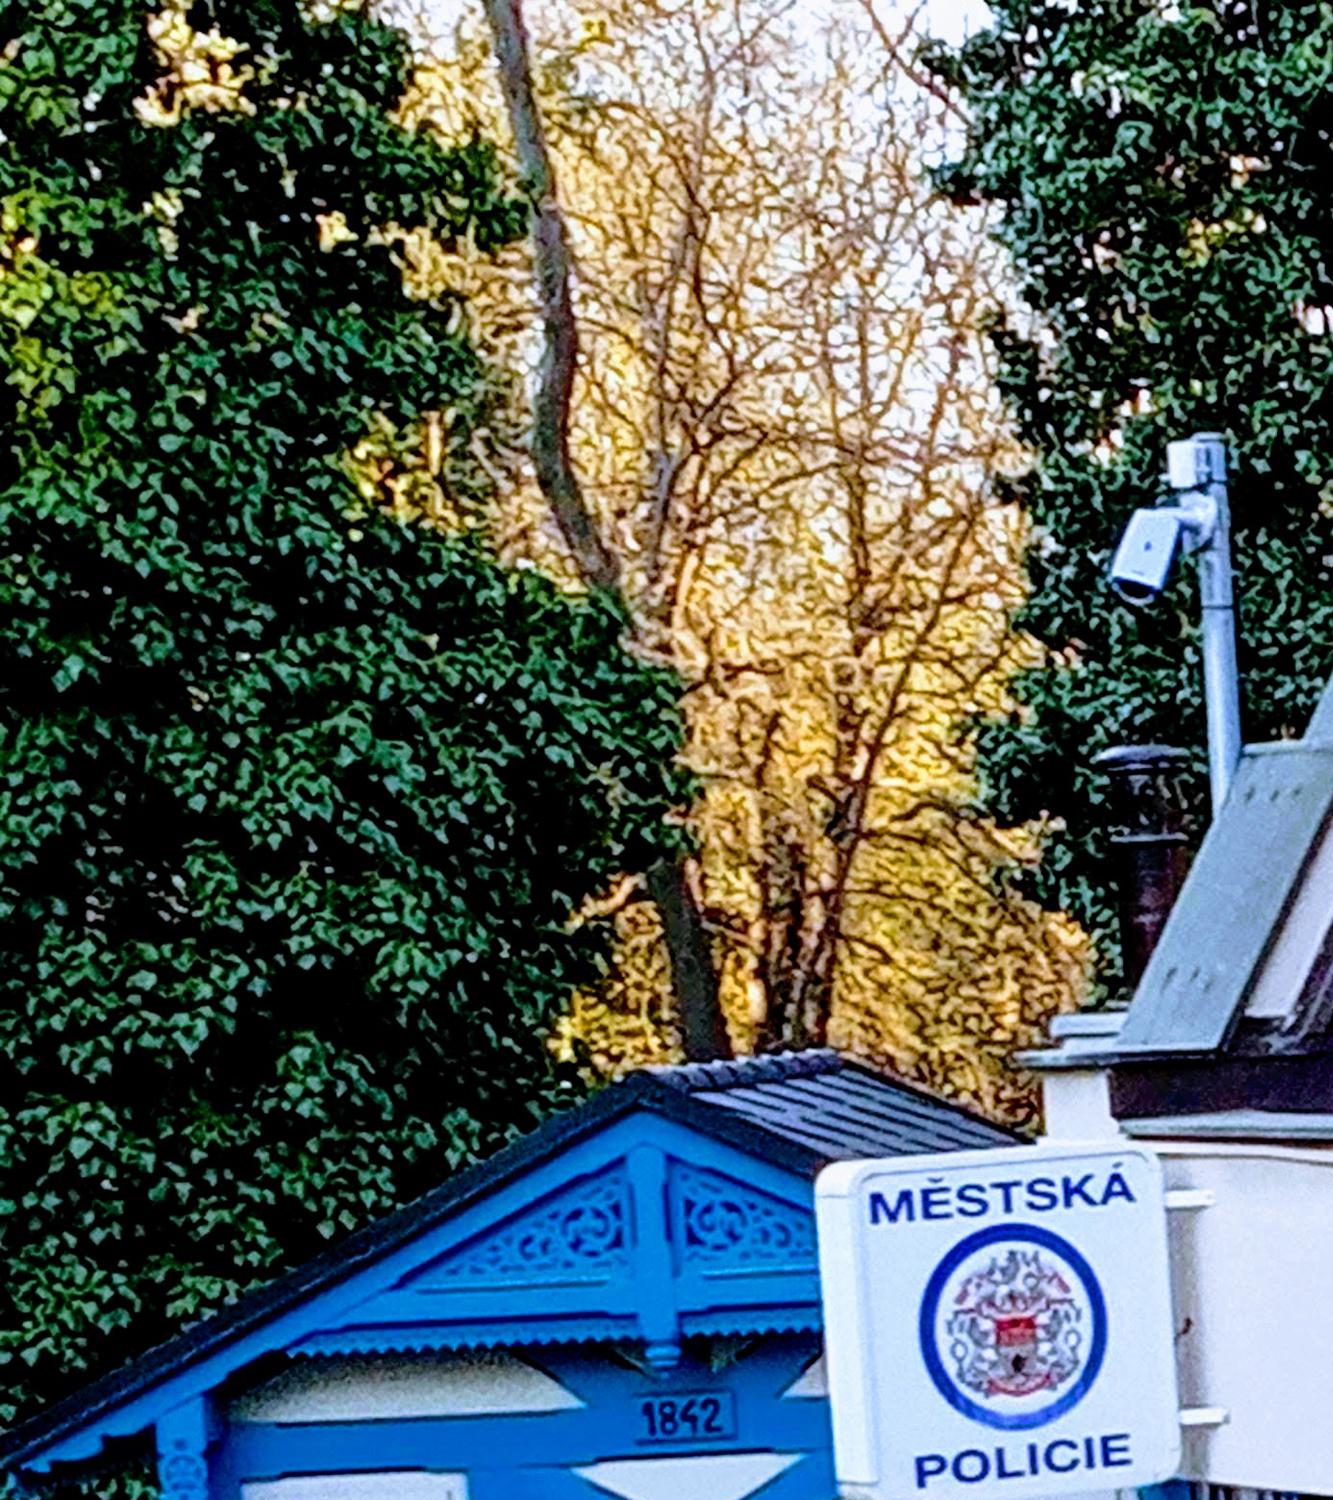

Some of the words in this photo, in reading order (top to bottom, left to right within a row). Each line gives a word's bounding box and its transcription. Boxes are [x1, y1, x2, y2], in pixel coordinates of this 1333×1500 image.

[868, 1162, 1137, 1225] MĚSTSKÁ
[641, 1397, 724, 1437] 1842
[914, 1432, 1133, 1489] POLICIE
